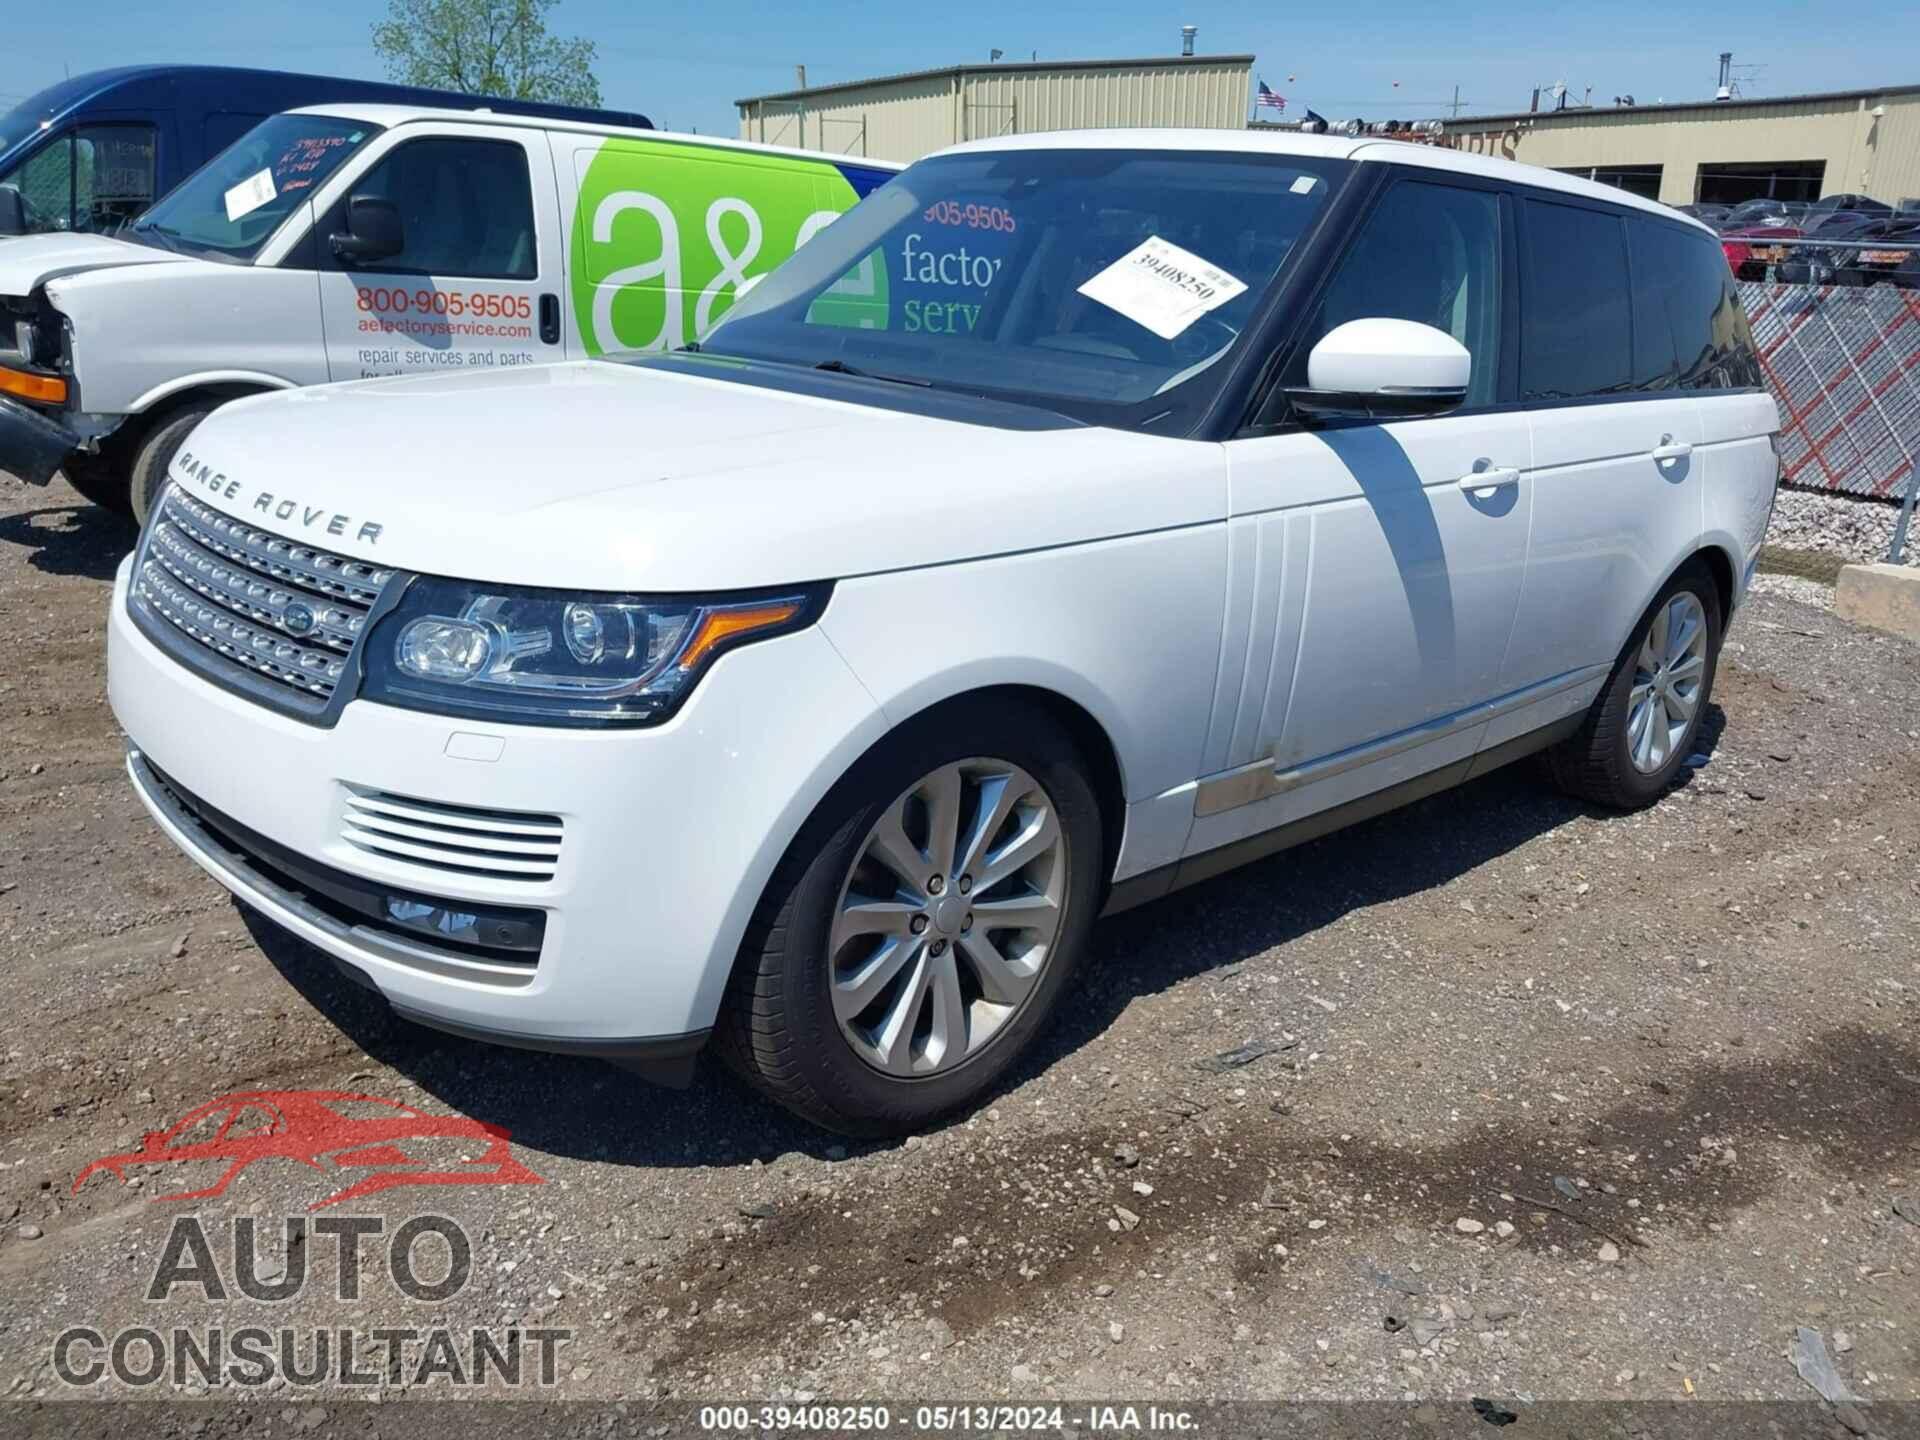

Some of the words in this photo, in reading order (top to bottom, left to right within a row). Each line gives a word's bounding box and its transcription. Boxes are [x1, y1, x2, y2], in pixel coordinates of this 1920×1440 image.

[1133, 253, 1215, 300] 39408250
[358, 318, 532, 337] aefactoryservice.com
[358, 347, 399, 366] repair
[406, 351, 463, 365] services
[468, 350, 494, 365] and
[500, 352, 533, 366] parts
[178, 452, 242, 500] RANGE
[253, 492, 383, 545] ROVER
